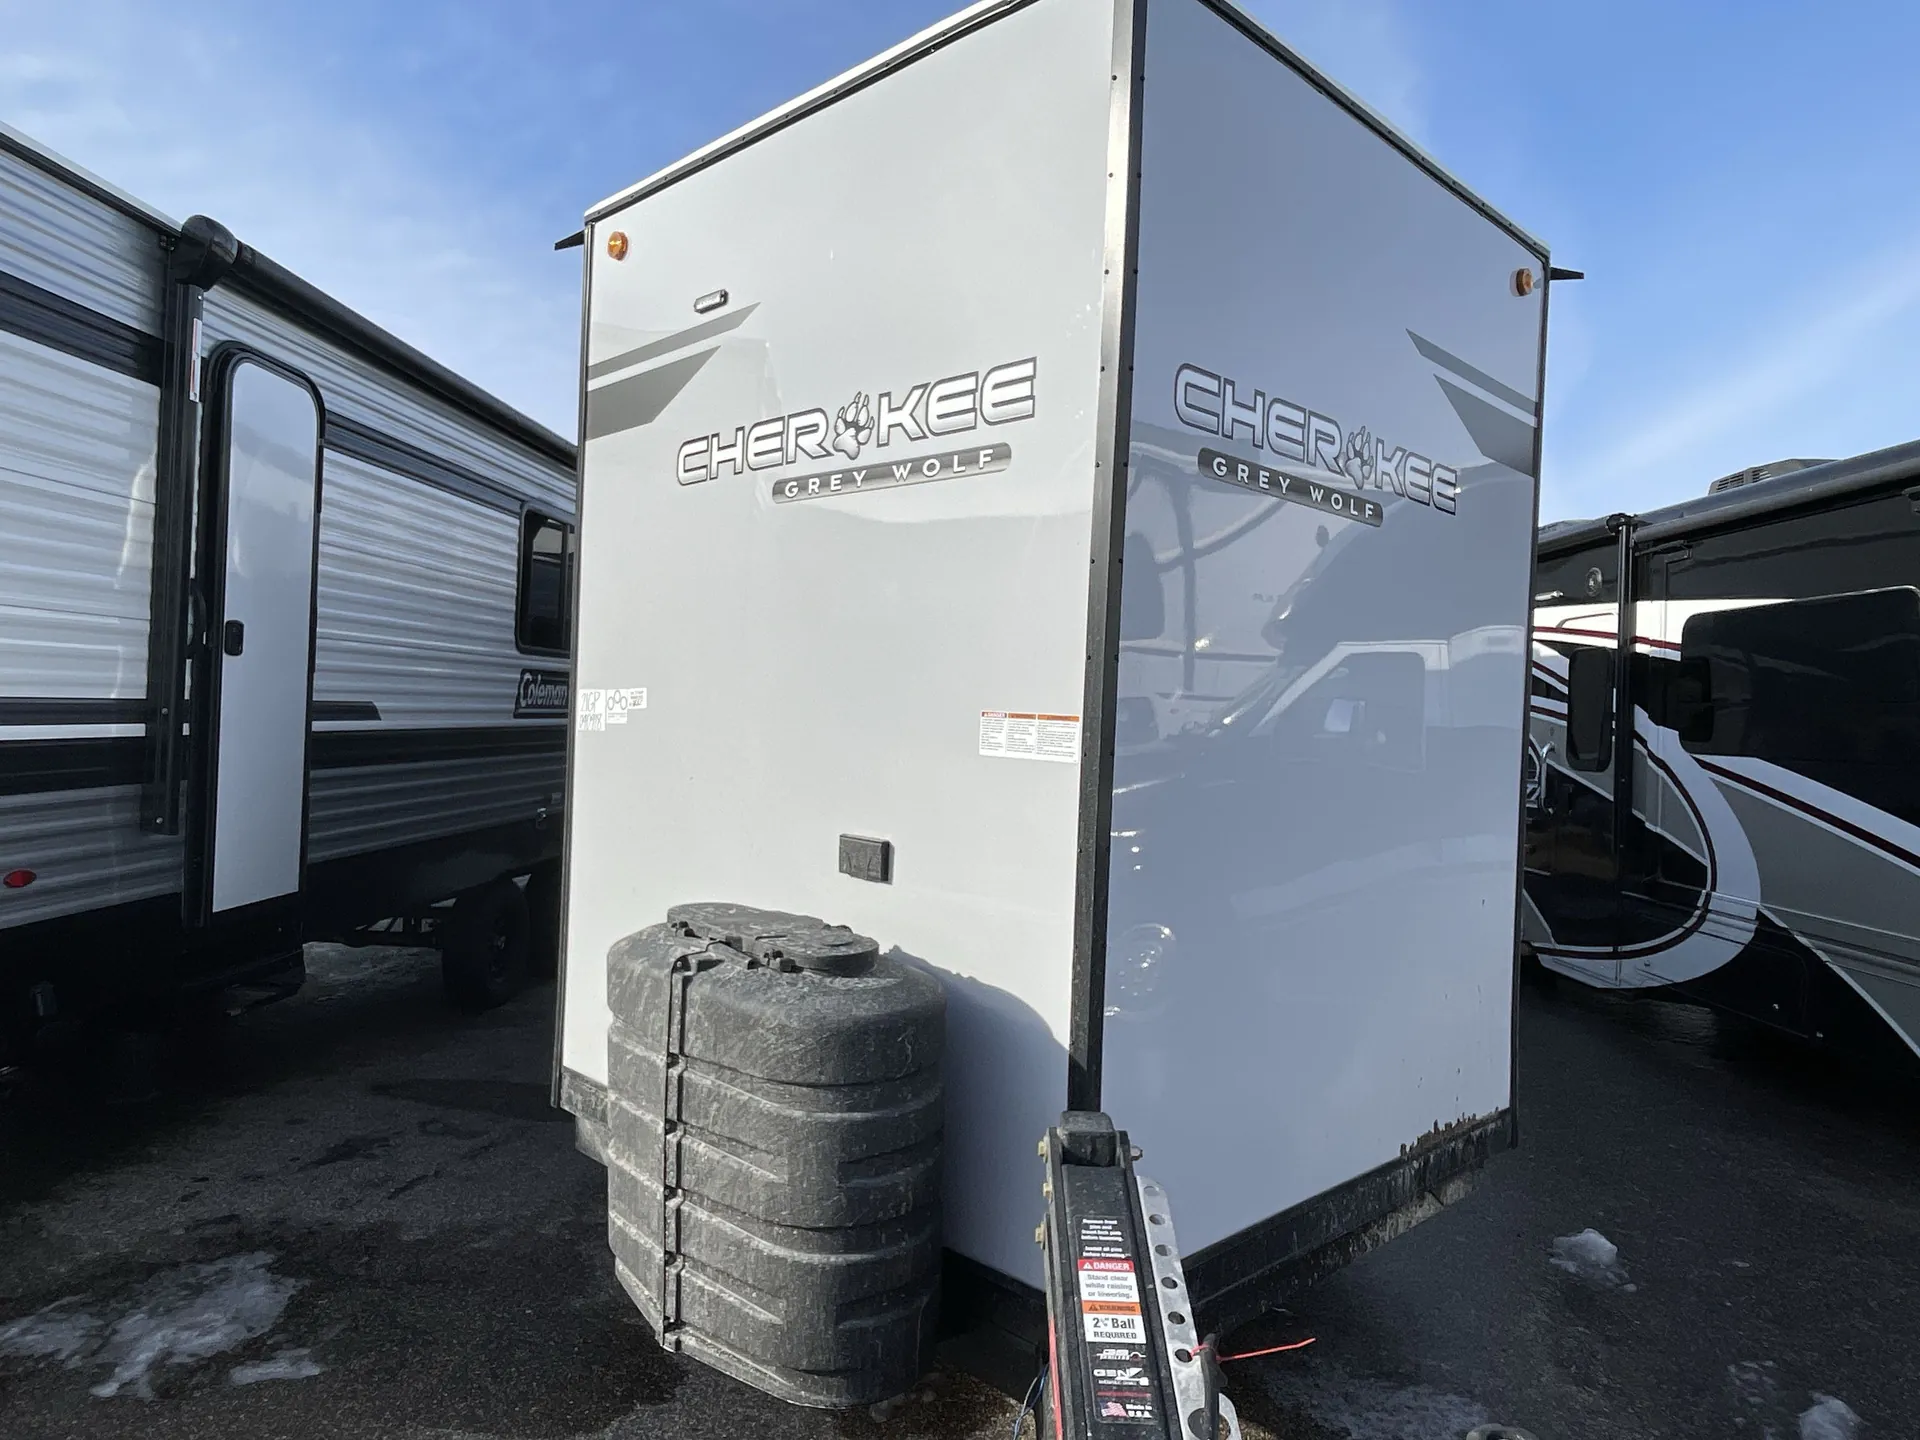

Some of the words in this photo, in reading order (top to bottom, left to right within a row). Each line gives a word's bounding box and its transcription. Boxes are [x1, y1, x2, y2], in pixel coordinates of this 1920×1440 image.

[785, 469, 868, 497] GREY
[892, 449, 994, 481] WOLF
[1212, 457, 1291, 495] GREY
[1310, 485, 1375, 518] WOLF
[520, 672, 568, 708] Coleman
[1093, 1262, 1130, 1270] DANGER
[1093, 1331, 1137, 1339] REQUIRED
[1111, 1318, 1135, 1329] Ball
